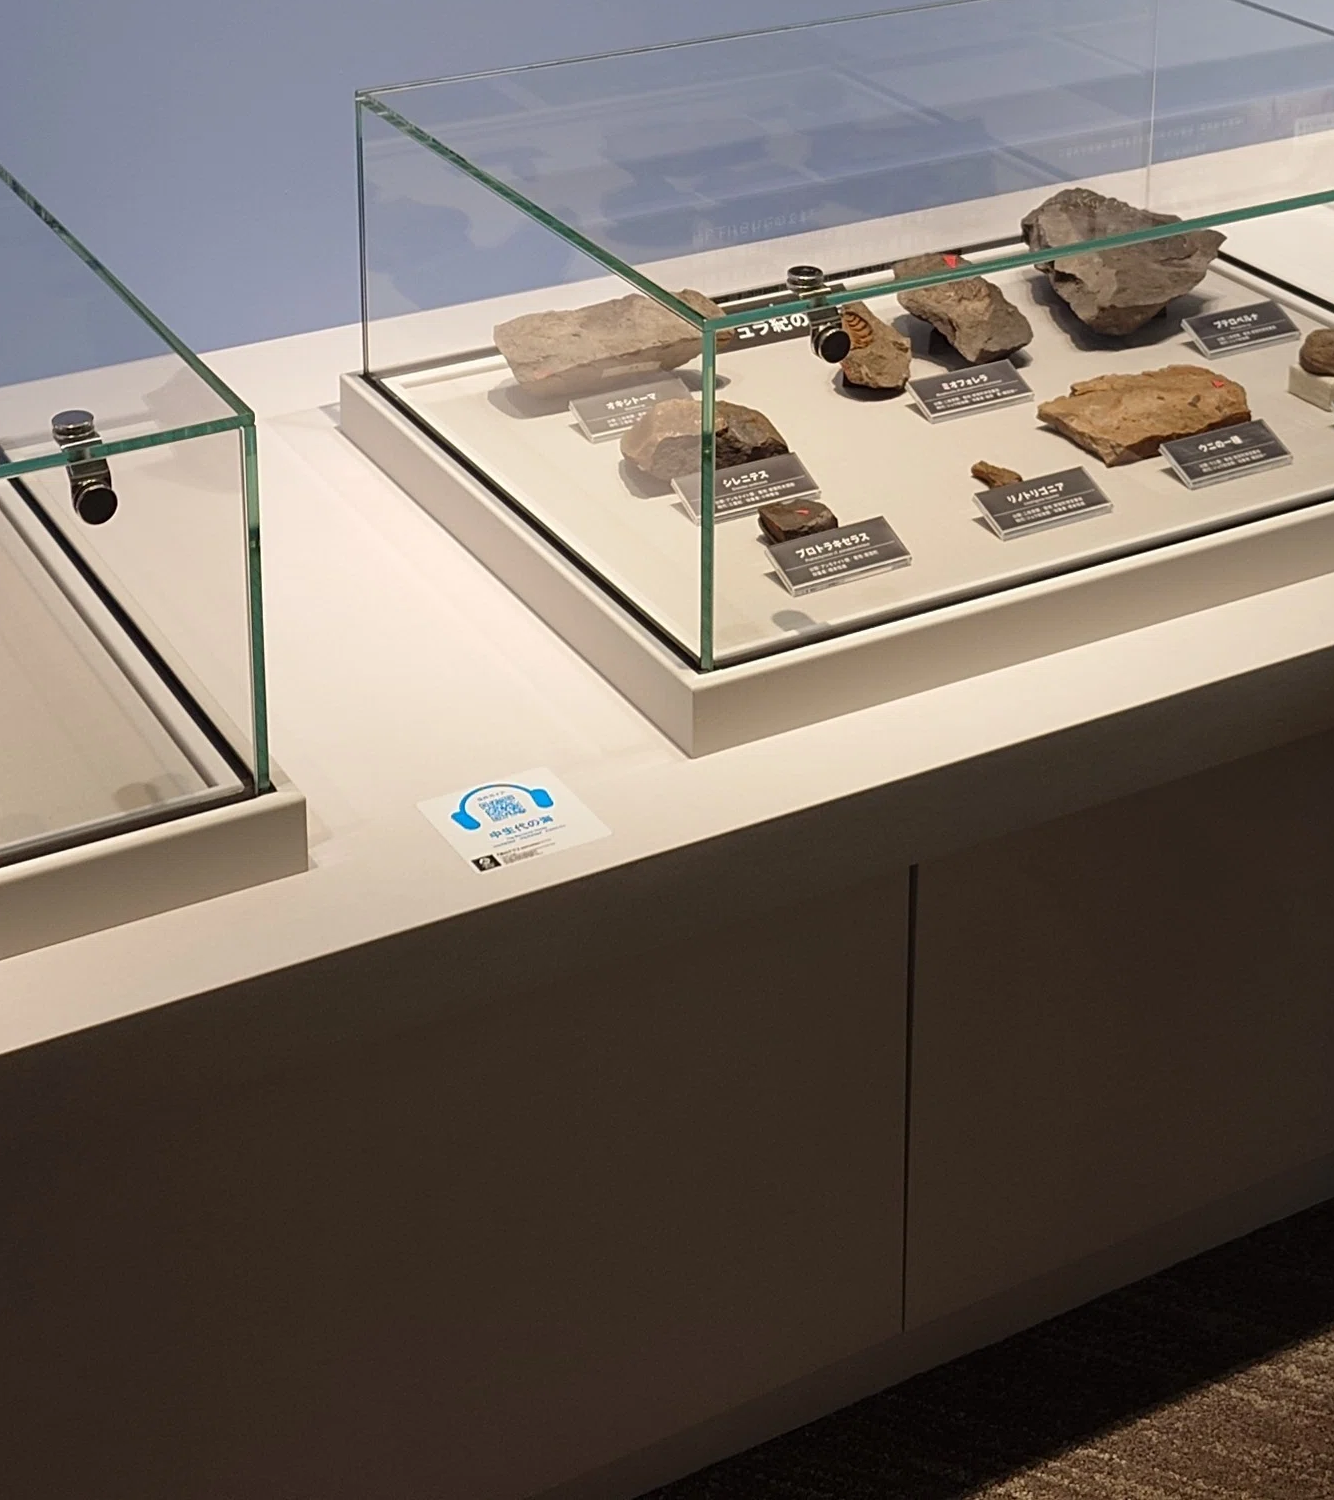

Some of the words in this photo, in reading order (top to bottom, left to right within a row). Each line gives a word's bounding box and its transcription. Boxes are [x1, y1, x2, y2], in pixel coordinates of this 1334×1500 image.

[942, 372, 989, 392] ミオフォレラ
[606, 392, 657, 411] オキシトーマ
[723, 470, 769, 488] シレニテス
[1006, 482, 1065, 504] リノトリゴニア
[796, 533, 870, 558] プロトラキセラス
